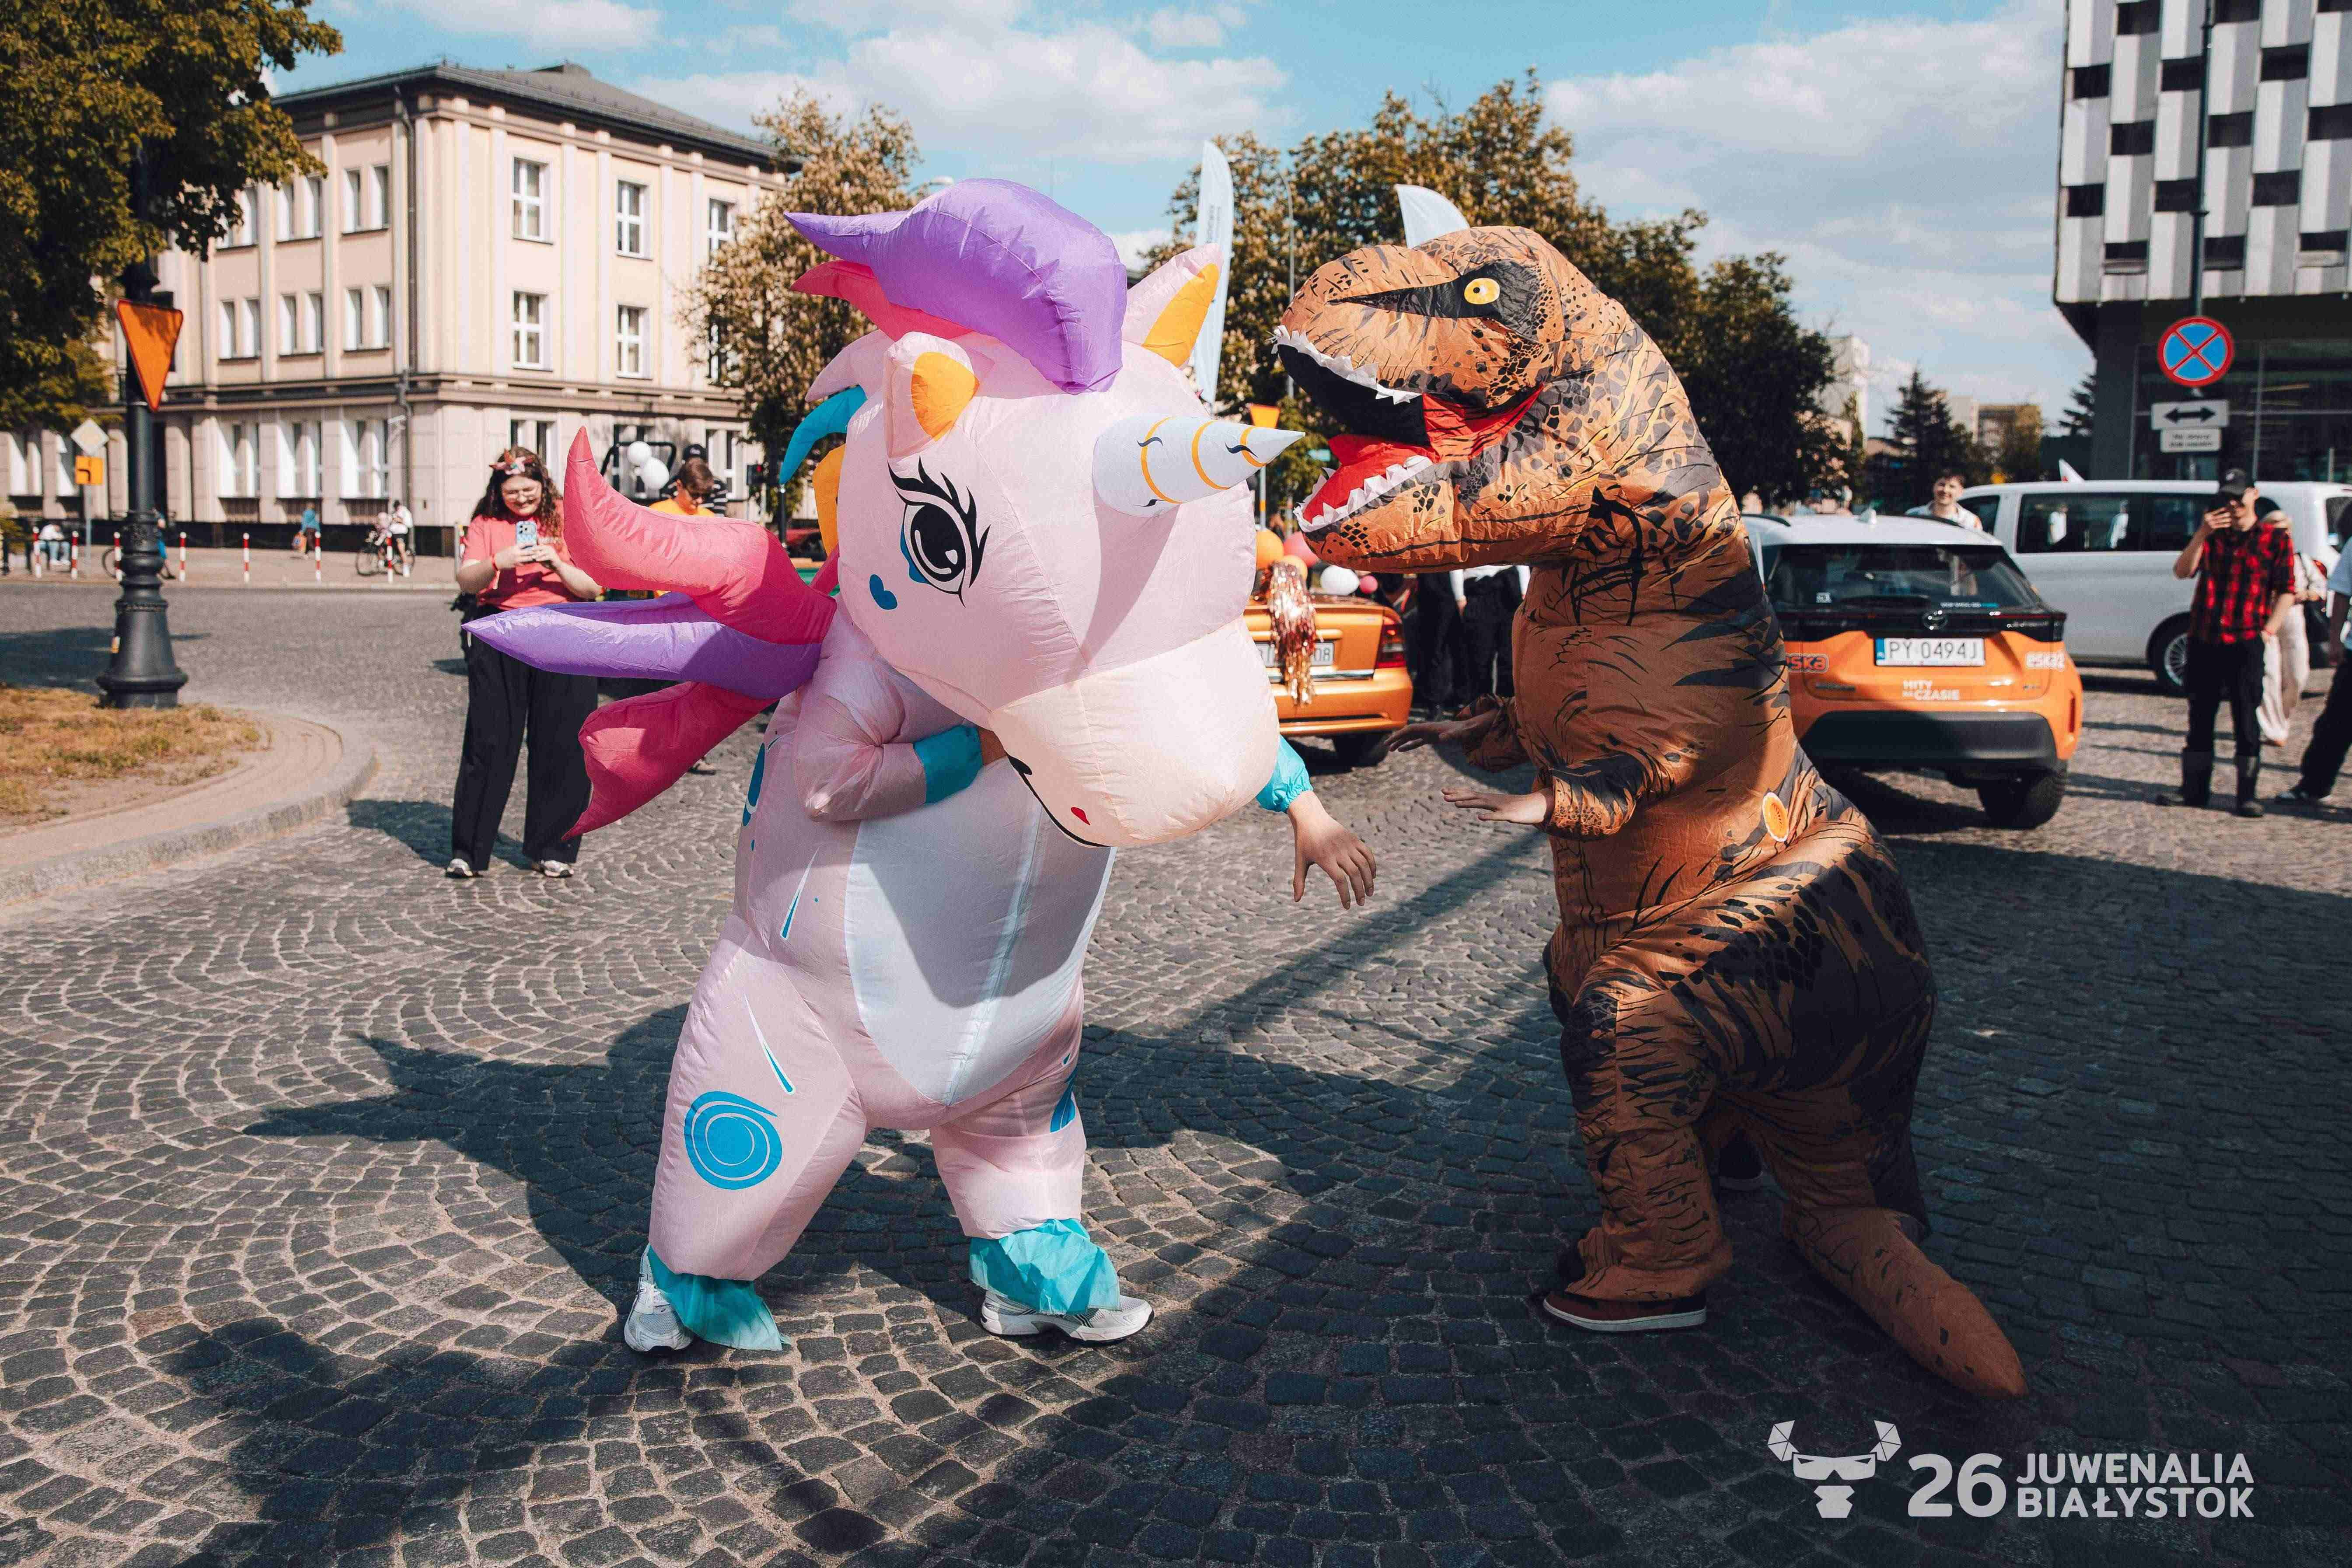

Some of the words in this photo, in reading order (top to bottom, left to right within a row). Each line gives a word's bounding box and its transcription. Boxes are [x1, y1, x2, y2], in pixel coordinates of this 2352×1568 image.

[1889, 641, 1912, 658] PY
[1921, 641, 1976, 659] 0494J
[1786, 655, 1826, 670] ska
[1903, 680, 1932, 689] HITY
[1914, 689, 1960, 700] CZASIE
